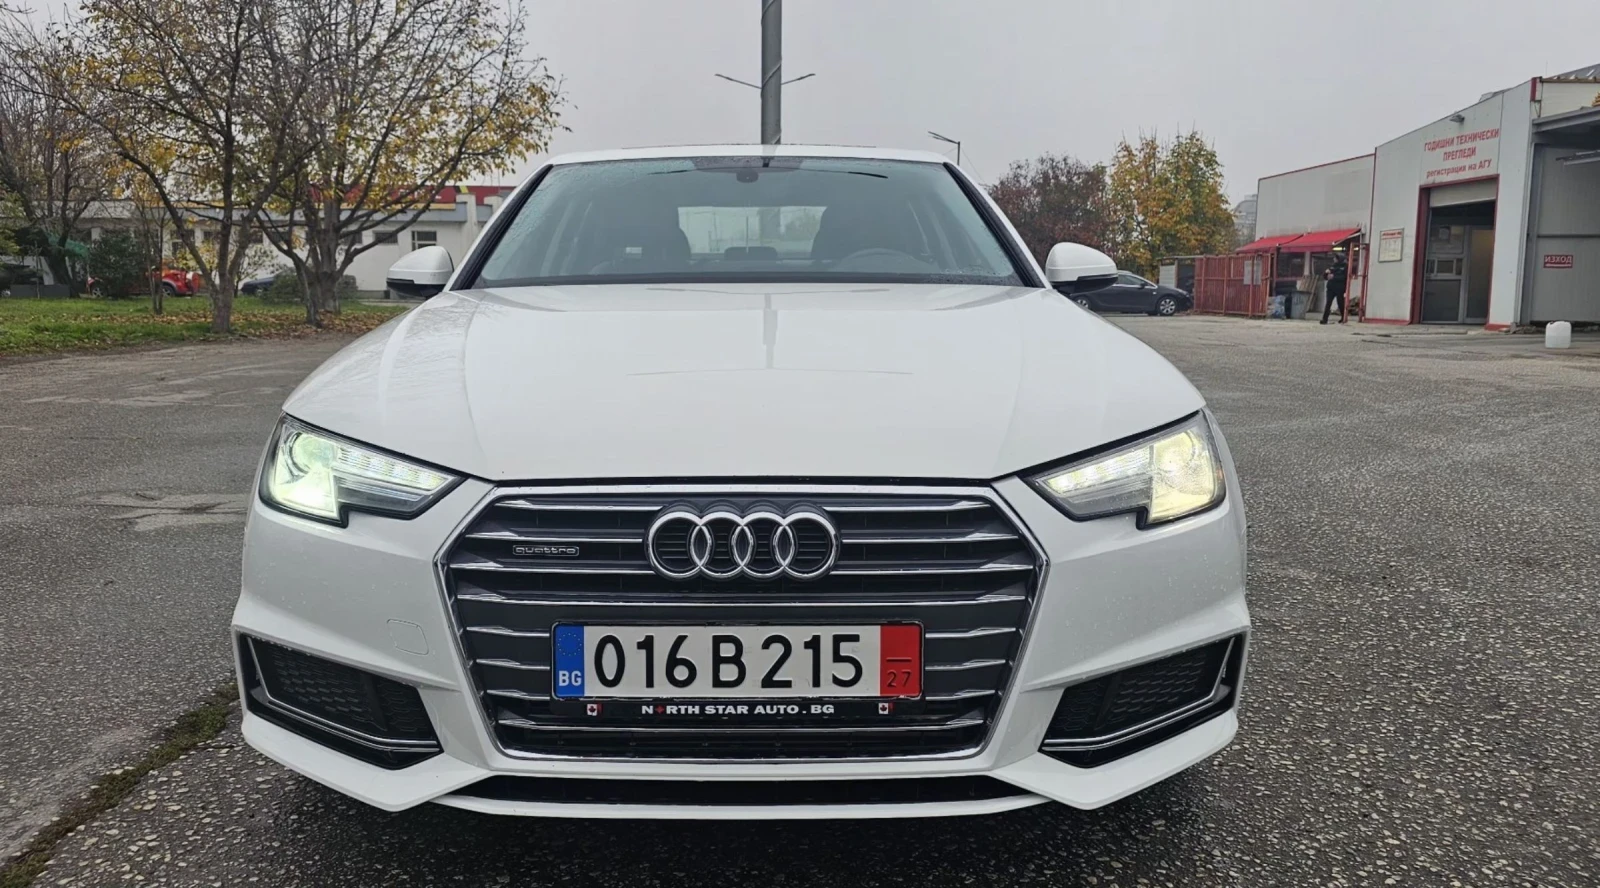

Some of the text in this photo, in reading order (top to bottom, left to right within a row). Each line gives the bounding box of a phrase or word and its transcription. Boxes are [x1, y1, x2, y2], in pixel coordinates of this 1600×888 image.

[1424, 128, 1499, 151] ГОДИШНИ ТЕХНИЧЕСКИ
[1443, 147, 1476, 161] ПРЕГЛЕДИ
[1426, 159, 1492, 178] регистрация на АГУ
[558, 670, 582, 687] BG
[887, 669, 912, 688] 27
[641, 705, 700, 715] NRTH
[704, 705, 749, 715] STAR
